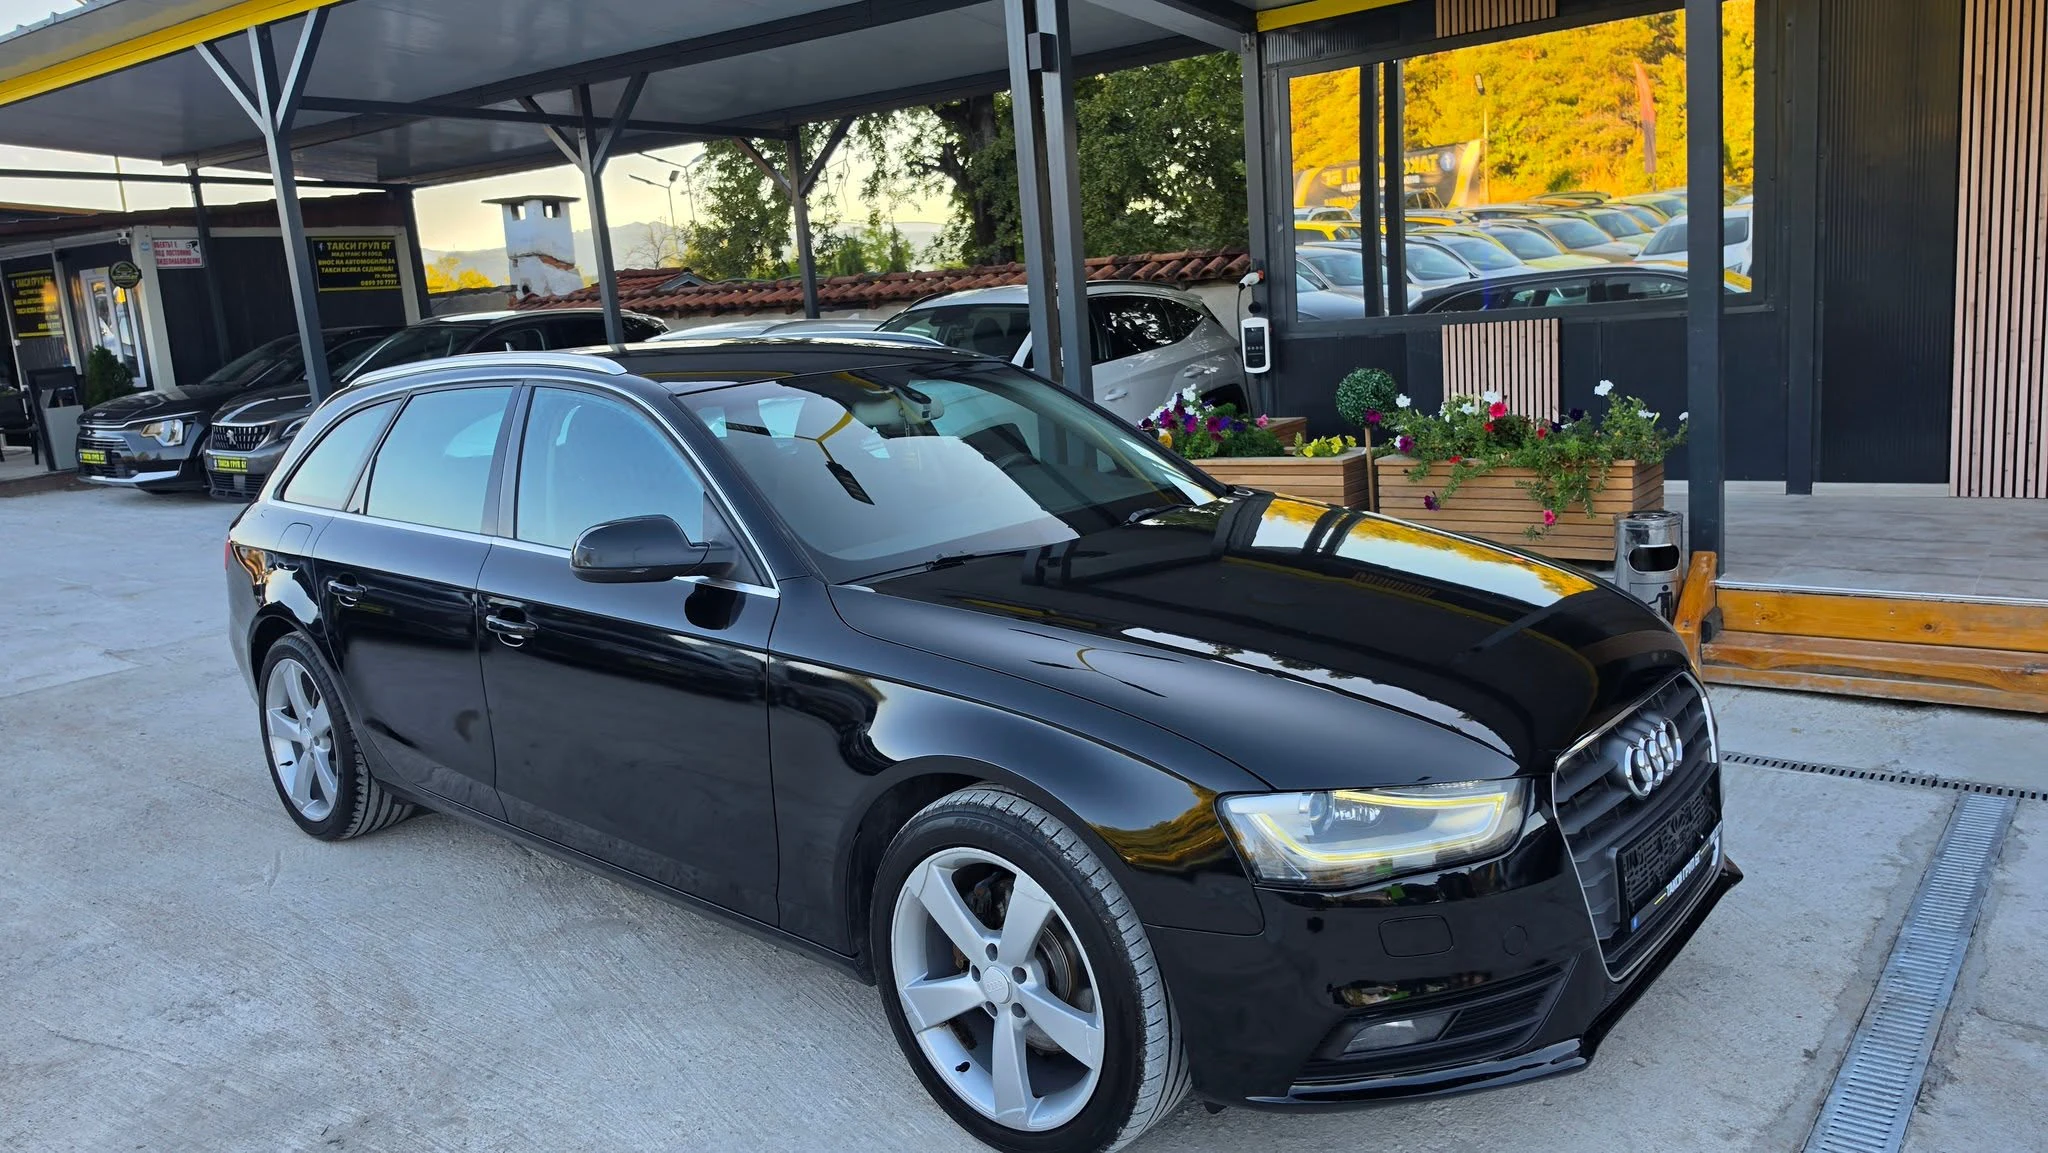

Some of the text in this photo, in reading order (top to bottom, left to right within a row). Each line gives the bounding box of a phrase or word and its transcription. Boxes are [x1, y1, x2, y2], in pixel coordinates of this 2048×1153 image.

[326, 242, 392, 250] ТАКСИ ГРУП БГ
